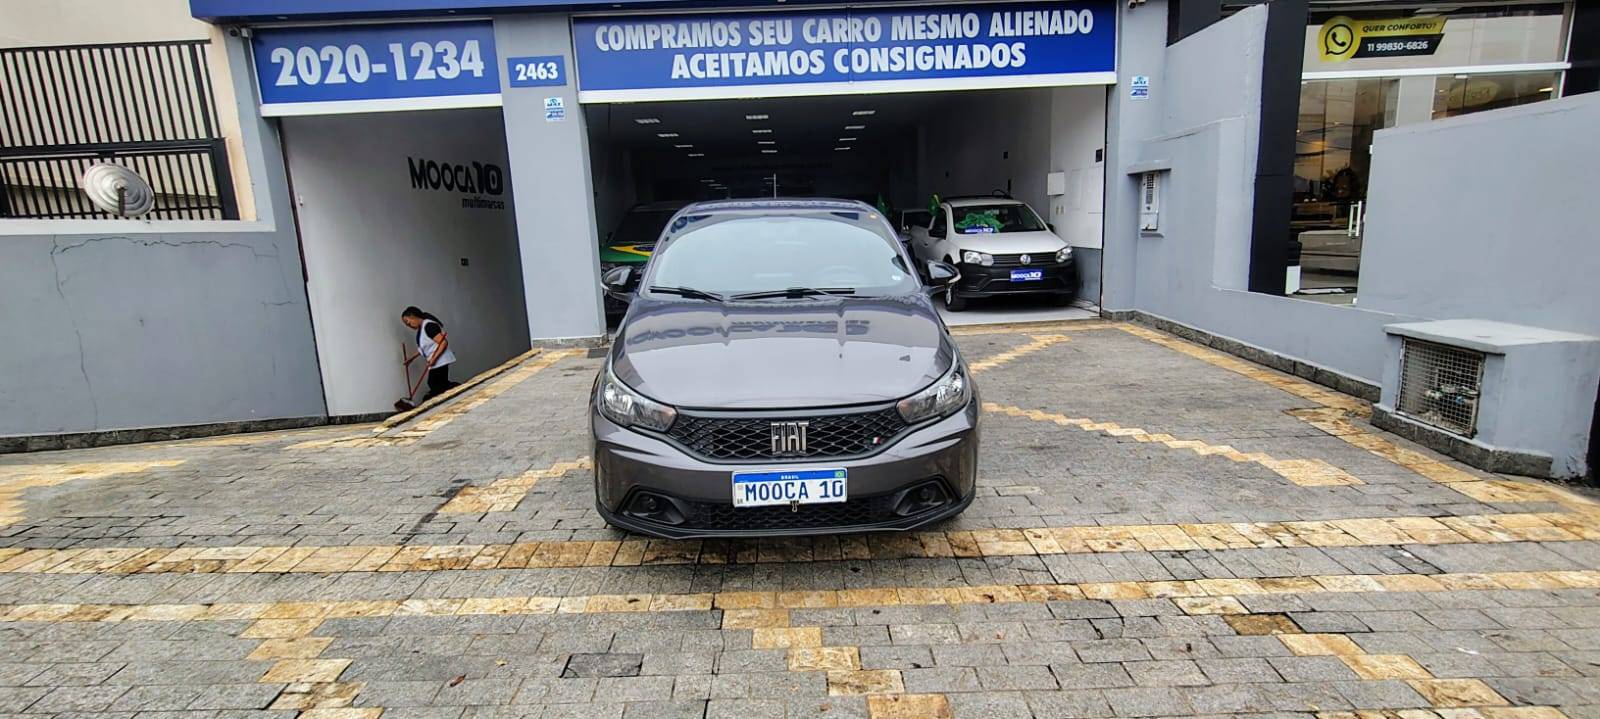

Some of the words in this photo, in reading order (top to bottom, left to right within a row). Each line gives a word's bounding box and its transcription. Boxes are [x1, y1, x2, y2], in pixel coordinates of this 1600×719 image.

[595, 21, 742, 51] COMPRAMOS
[749, 18, 793, 46] SEU
[802, 17, 881, 44] CARRO
[891, 12, 980, 41] MESMO
[989, 9, 1094, 37] ALIENADO
[1362, 24, 1386, 33] QUER
[1387, 23, 1438, 31] CONFORTO?
[1367, 43, 1375, 51] 11
[1376, 41, 1428, 51] 99830-6826
[271, 40, 484, 86] 2020-1234
[515, 62, 559, 81] 2463
[671, 49, 825, 79] ACEITAMOS
[833, 42, 1026, 74] CONSIGNADOS
[770, 421, 809, 453] FIAT
[745, 481, 809, 501] MOOCA
[819, 480, 844, 498] 10
